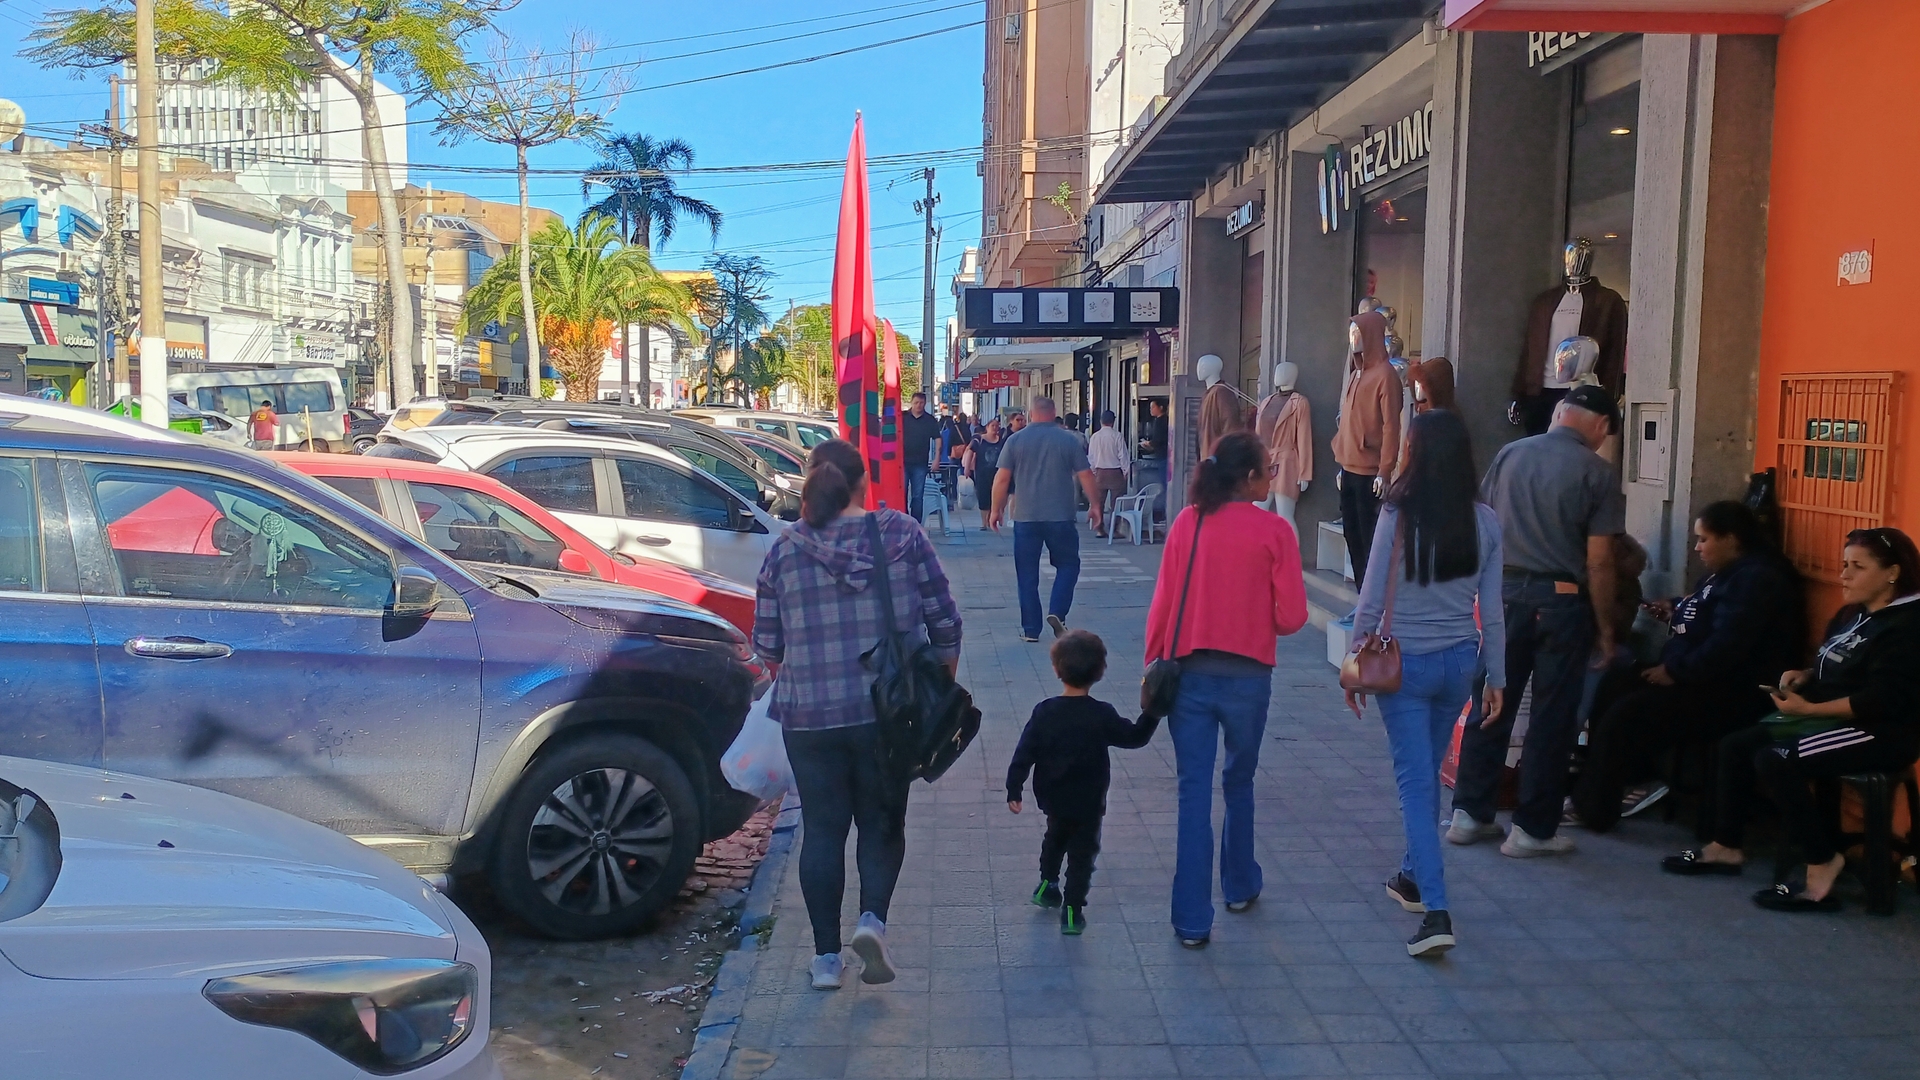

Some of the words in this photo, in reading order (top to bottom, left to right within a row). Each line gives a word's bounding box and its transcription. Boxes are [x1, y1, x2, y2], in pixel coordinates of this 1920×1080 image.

[1350, 99, 1434, 189] REZUMO
[1226, 200, 1253, 236] REZUMO
[1842, 249, 1869, 276] 876
[174, 345, 203, 360] sorvete
